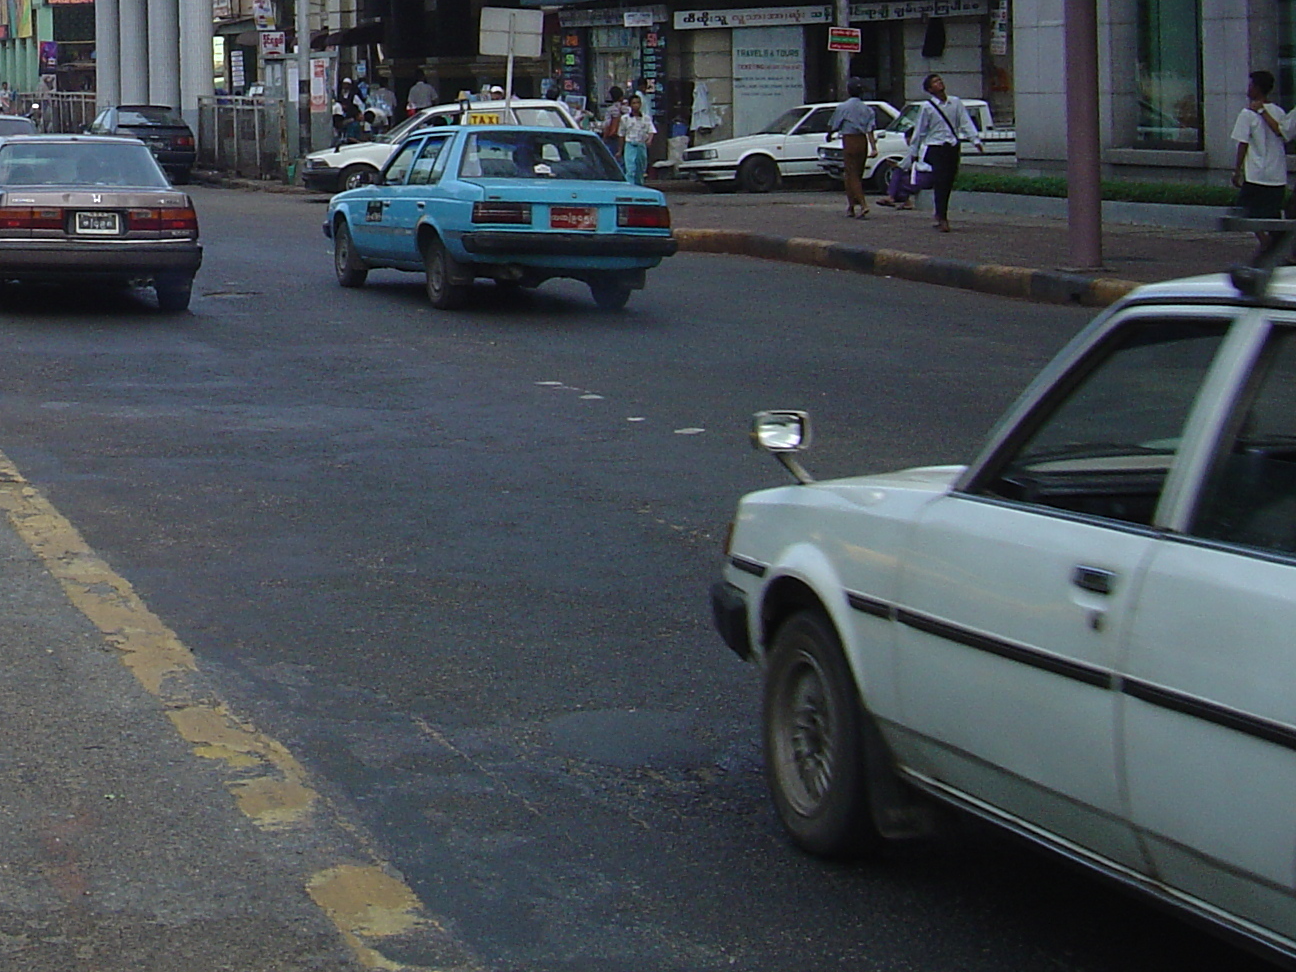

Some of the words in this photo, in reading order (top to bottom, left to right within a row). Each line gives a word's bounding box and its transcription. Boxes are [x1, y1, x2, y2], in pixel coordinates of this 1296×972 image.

[737, 49, 768, 57] TRAVELS
[776, 49, 799, 57] TOURS
[471, 115, 499, 124] TAXI
